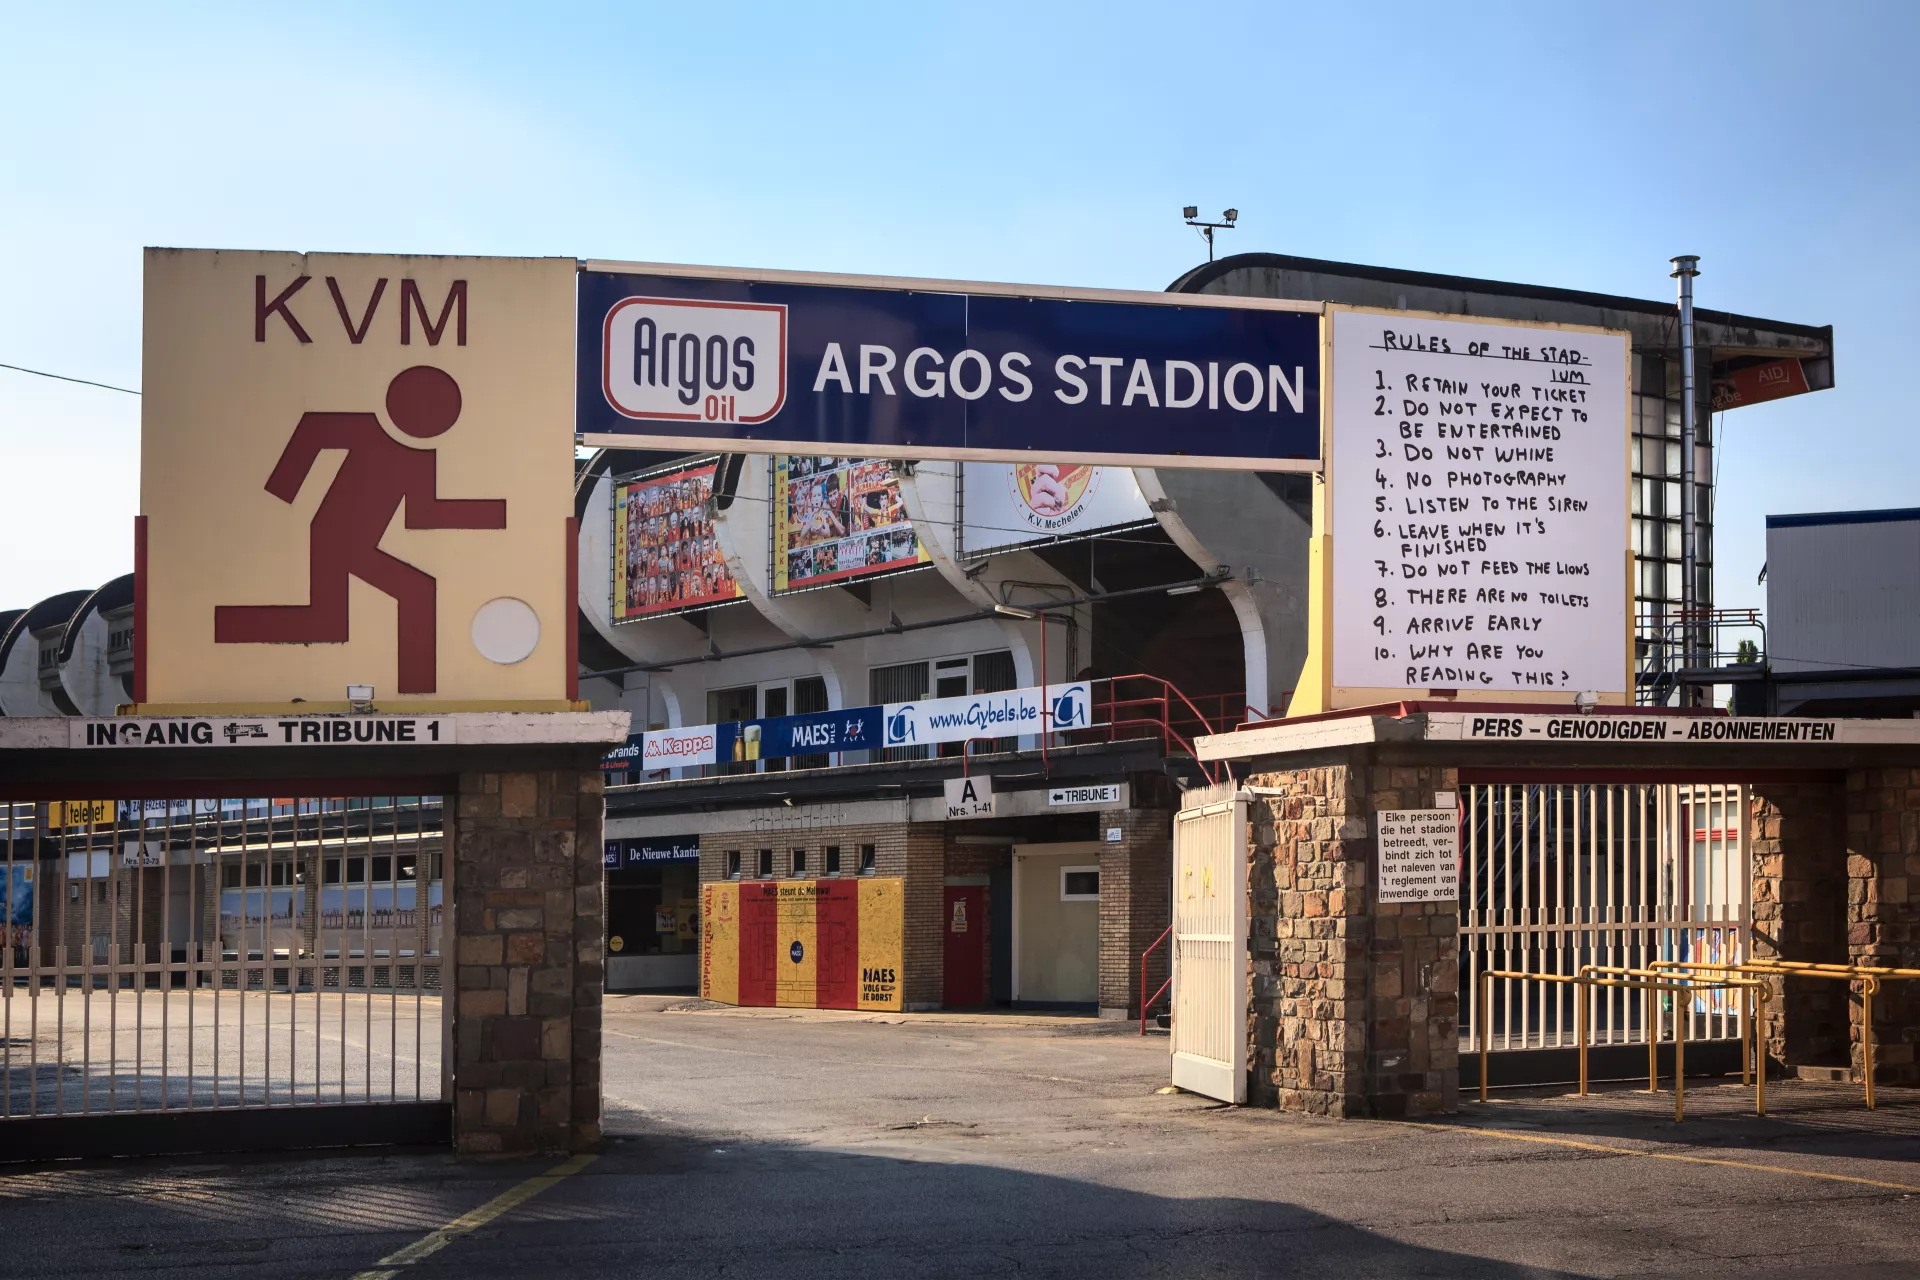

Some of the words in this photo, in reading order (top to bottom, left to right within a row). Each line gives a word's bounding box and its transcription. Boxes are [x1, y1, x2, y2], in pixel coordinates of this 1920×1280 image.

[255, 275, 467, 346] KVM
[1384, 330, 1451, 353] RULES
[1468, 342, 1489, 356] OF
[1502, 346, 1530, 360] THE
[1540, 347, 1589, 365] STAD-
[633, 317, 755, 406] Argos
[813, 342, 1033, 403] ARGOS
[1054, 354, 1304, 414] STADION
[1759, 366, 1783, 383] AID
[1375, 370, 1392, 391] 1.
[1406, 374, 1468, 396] RETAIN
[1481, 383, 1521, 399] YOUR
[1532, 387, 1586, 404] TICKET
[705, 394, 735, 422] Oil
[1374, 395, 1393, 416] 2.
[1403, 400, 1429, 416] DO
[1440, 402, 1478, 417] NOT
[1491, 402, 1564, 422] EXPECT
[1572, 409, 1588, 423] TO
[1400, 421, 1424, 439] BE
[1438, 422, 1561, 441] ENTERTAINED
[1375, 439, 1393, 459] 3.
[1404, 444, 1433, 462] DO
[1447, 446, 1485, 461] NOT
[1495, 447, 1554, 463] WHINE
[1375, 468, 1394, 489] 4.
[1407, 472, 1432, 489] NO
[1448, 470, 1567, 489] PHOTOGRAPHY
[1375, 496, 1393, 513] 5.
[1406, 497, 1469, 515] LISTEN
[1482, 496, 1499, 511] TO
[1506, 497, 1538, 511] THE
[1548, 496, 1588, 513] SIREN
[1028, 513, 1042, 528] K.V.
[1045, 504, 1084, 529] Mechelen
[1374, 520, 1391, 538] 6.
[1399, 524, 1449, 540] LEAVE
[1459, 522, 1506, 537] WHEN
[1517, 517, 1546, 535] IT'S
[1401, 538, 1487, 559] FINISHED
[1374, 560, 1394, 578] 7.
[1402, 563, 1428, 579] DO
[1438, 561, 1471, 576] NOT
[1482, 561, 1519, 575] FEED
[1526, 561, 1551, 575] THE
[1557, 561, 1590, 576] LIONS
[1374, 588, 1395, 609] 8.
[1407, 588, 1467, 605] THERE
[1476, 587, 1505, 603] ARE
[1512, 592, 1528, 603] NO
[1540, 592, 1589, 608] TOILETS
[1374, 616, 1392, 636] 9.
[1407, 616, 1474, 635] ARRIVE
[1488, 615, 1542, 632] EARLY
[1375, 646, 1396, 661] 10.
[1410, 645, 1453, 661] WHY
[1467, 643, 1503, 660] ARE
[1517, 644, 1544, 660] YOU
[1407, 666, 1493, 686] READING
[929, 697, 1036, 730] www.Gybels.be
[279, 720, 416, 743] TRIBUNE
[427, 721, 440, 742] 1
[792, 723, 829, 747] MAES
[1472, 718, 1522, 738] PERS
[1547, 719, 1667, 740] GENODIGDEN
[1688, 721, 1835, 741] ABONNEMENTEN
[663, 735, 714, 756] Kappa
[961, 780, 978, 804] A
[1065, 788, 1108, 802] TRIBUNE
[1112, 788, 1117, 800] 1
[949, 805, 968, 818] Nrs.
[974, 803, 992, 814] 1-41
[1386, 813, 1405, 821] Elke
[1411, 813, 1450, 823] persoon
[1381, 826, 1395, 835] die
[1400, 826, 1415, 834] het
[1421, 824, 1455, 833] stadion
[137, 843, 149, 857] A
[1384, 838, 1428, 848] betreedt,
[1433, 838, 1453, 846] ver-
[604, 853, 615, 864] AES
[630, 848, 641, 861] De
[642, 847, 671, 861] Nieuwe
[1385, 851, 1410, 860] bindt
[1415, 850, 1434, 859] zich
[1439, 850, 1452, 858] tot
[1382, 864, 1396, 873] het
[1402, 863, 1435, 872] naleven
[1381, 877, 1387, 885] 't
[1392, 876, 1436, 887] reglement
[1381, 889, 1428, 899] inwendige
[1434, 887, 1454, 896] orde
[703, 921, 712, 998] SUPPORTERS
[863, 968, 895, 983] MAES
[863, 984, 880, 992] VOLG
[863, 993, 870, 1001] JE
[871, 993, 892, 1002] DORST
